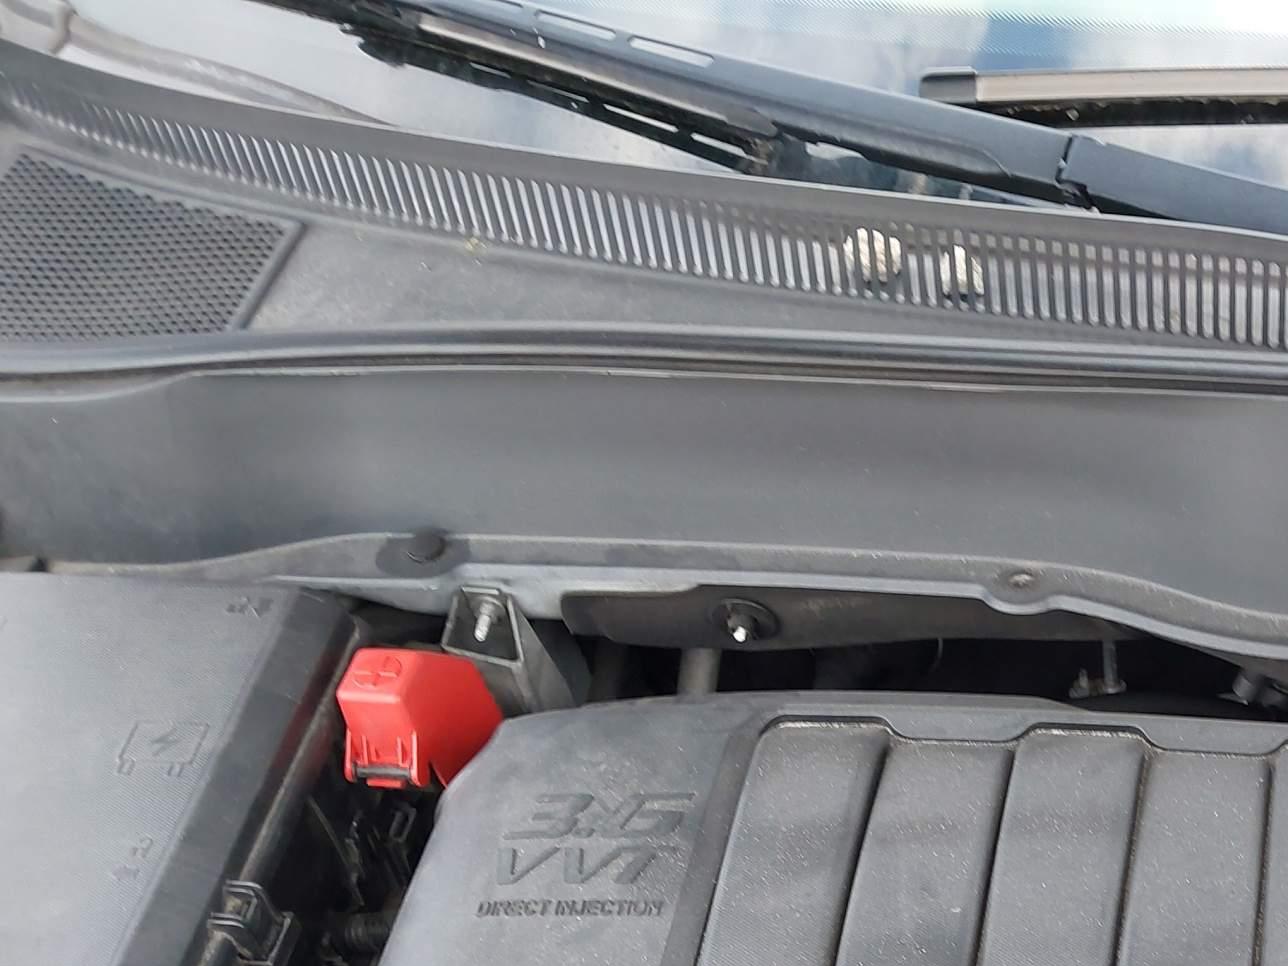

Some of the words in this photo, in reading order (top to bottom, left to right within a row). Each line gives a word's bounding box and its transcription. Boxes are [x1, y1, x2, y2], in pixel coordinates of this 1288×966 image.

[497, 846, 668, 885] VVT
[477, 899, 552, 917] DIRECT
[555, 899, 665, 917] INJECTION
